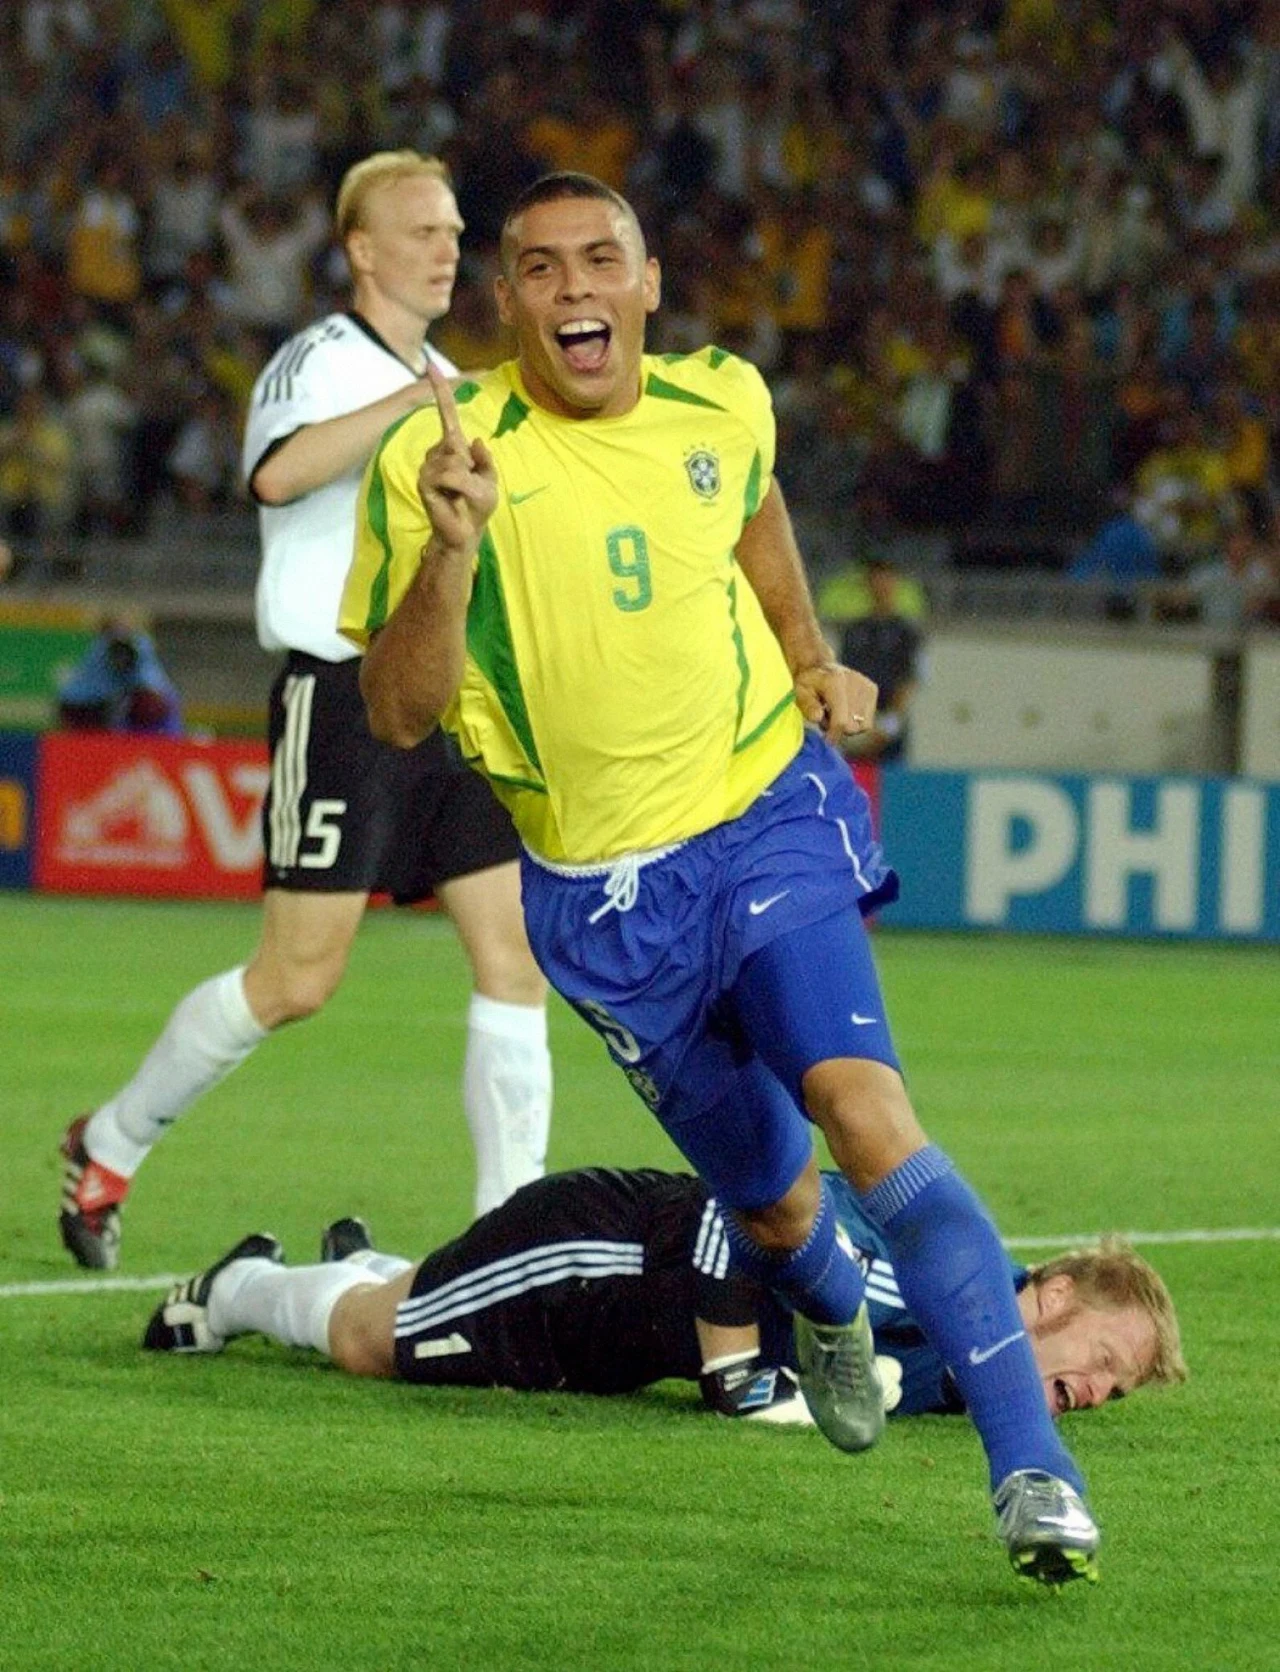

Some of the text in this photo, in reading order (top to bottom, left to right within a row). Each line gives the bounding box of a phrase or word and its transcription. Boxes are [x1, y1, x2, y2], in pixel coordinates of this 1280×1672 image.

[606, 526, 652, 612] 9
[300, 800, 346, 869] 5
[964, 779, 1264, 933] PHI
[414, 1332, 472, 1359] 1
